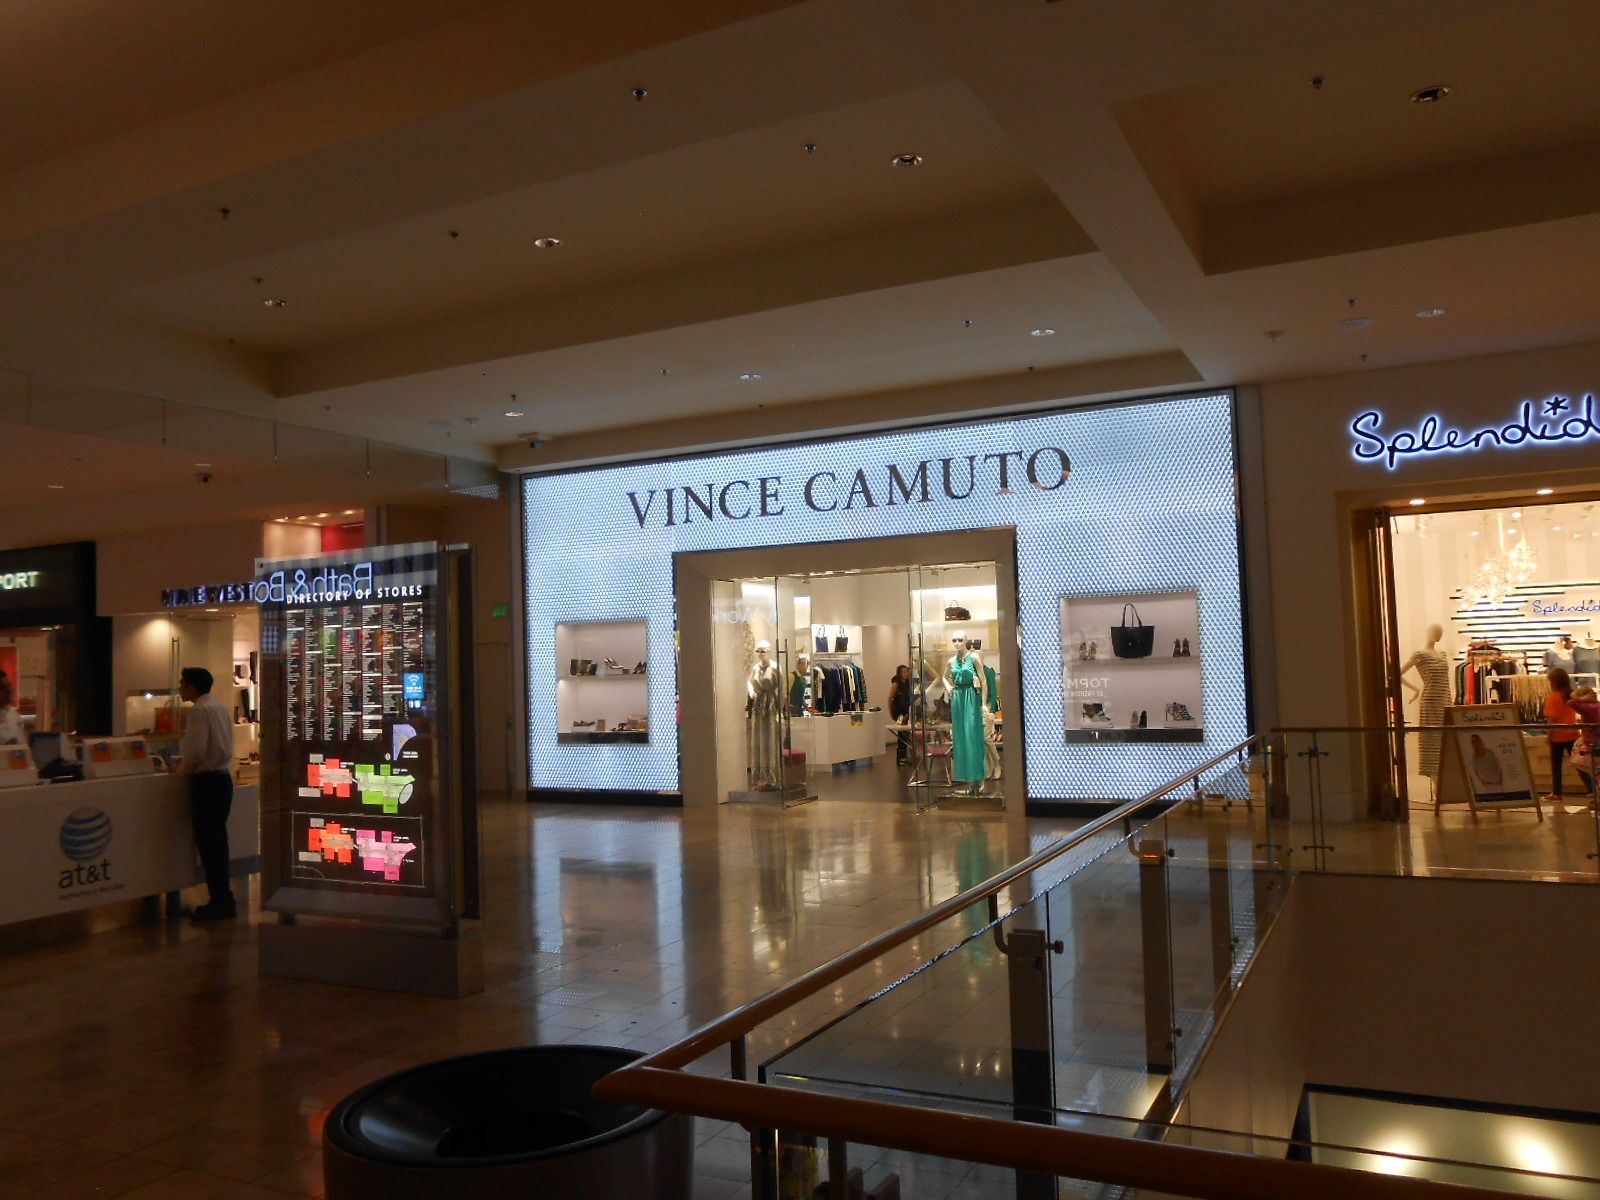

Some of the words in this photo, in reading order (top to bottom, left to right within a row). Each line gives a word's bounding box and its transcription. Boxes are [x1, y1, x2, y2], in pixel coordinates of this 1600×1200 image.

[1351, 395, 1600, 469] Splendid
[627, 475, 785, 529] VINCE
[804, 446, 1072, 512] CAMUTO
[286, 590, 349, 604] DIRECTORY
[355, 588, 371, 600] OF
[377, 584, 423, 599] STORES
[1532, 599, 1600, 616] Splendid
[58, 858, 112, 889] at&t
